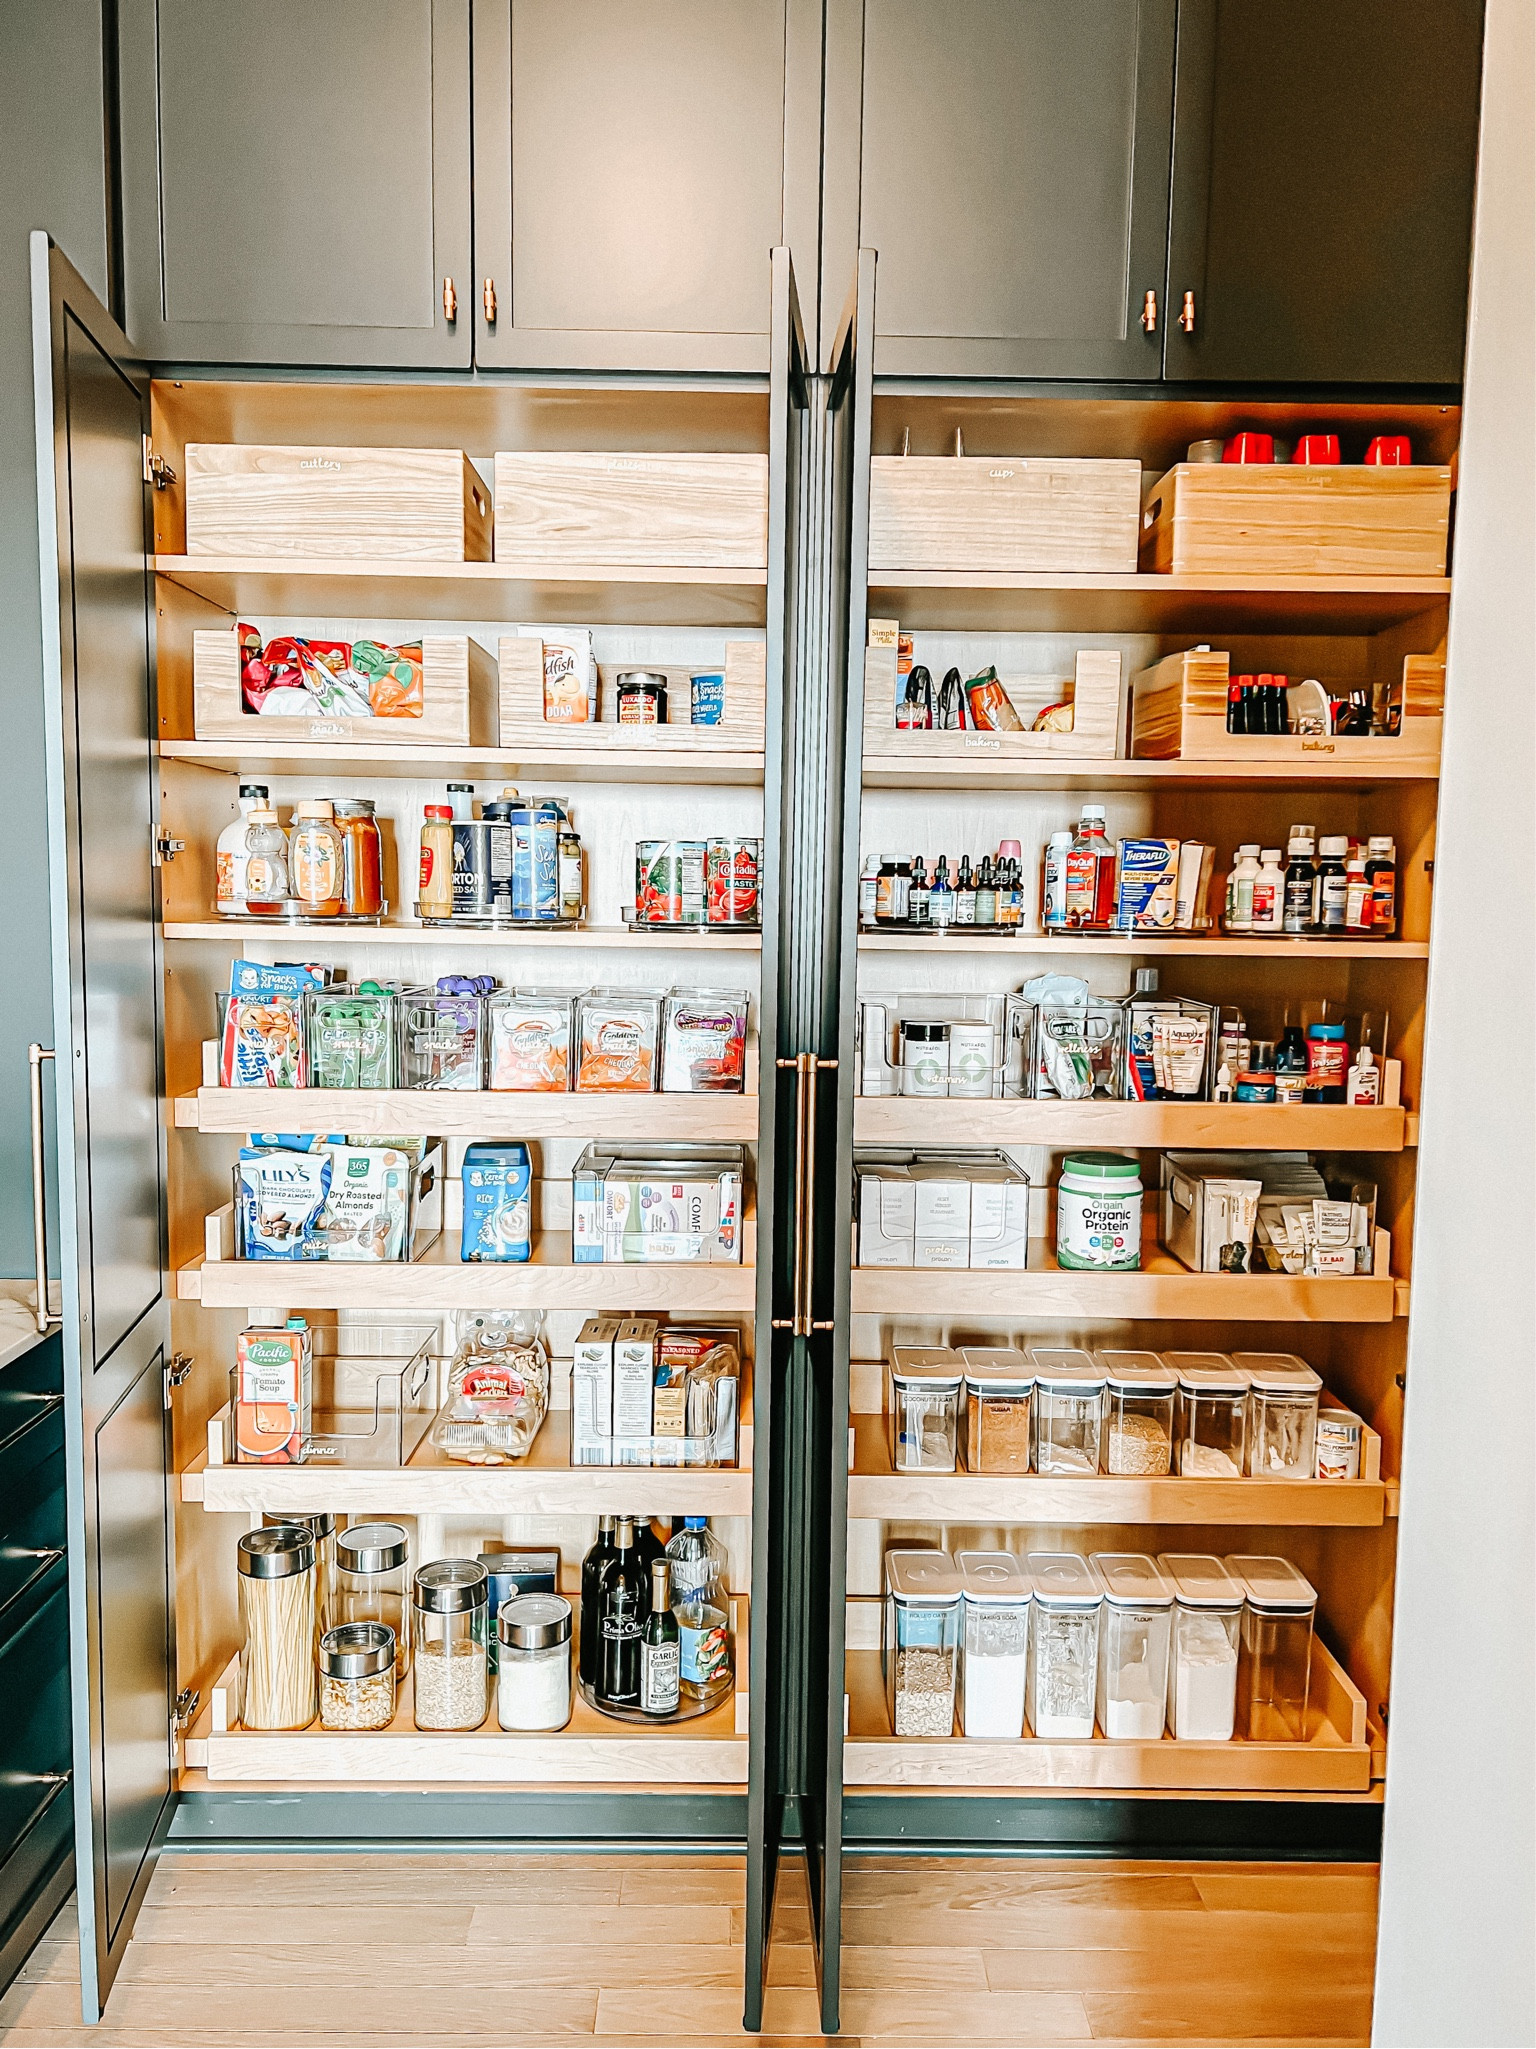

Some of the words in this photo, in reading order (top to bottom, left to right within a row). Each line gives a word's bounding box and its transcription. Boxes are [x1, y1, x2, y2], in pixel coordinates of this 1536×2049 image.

[300, 457, 341, 471] cutlery
[989, 469, 1015, 479] cups
[964, 735, 1000, 750] baking
[1302, 741, 1335, 753] baking
[1125, 849, 1166, 862] THERAFLU
[1067, 857, 1095, 869] DayQuil
[540, 862, 556, 881] Sal
[720, 863, 757, 877] Cotadin
[261, 973, 297, 985] Snacks
[261, 981, 272, 989] for
[274, 984, 293, 992] Baby
[1171, 1030, 1204, 1039] Aquaphr
[332, 1038, 369, 1049] snacks
[422, 1038, 462, 1050] snacks
[1058, 1043, 1102, 1054] wellness
[927, 1074, 968, 1085] vitamins
[349, 1161, 368, 1171] 365
[484, 1173, 505, 1181] Cereal
[343, 1180, 369, 1190] Organic
[329, 1191, 345, 1200] Dry
[346, 1190, 382, 1200] Roasted
[476, 1194, 494, 1204] RICE
[335, 1201, 374, 1210] Almonds
[1092, 1200, 1123, 1211] Orgain
[1082, 1208, 1132, 1222] Organic
[691, 1196, 702, 1254] COMFRT
[1085, 1219, 1129, 1231] Protein
[302, 1240, 329, 1250] nuts
[649, 1242, 676, 1255] baby
[924, 1243, 960, 1256] prolon
[1280, 1249, 1305, 1258] rolon
[249, 1343, 289, 1359] Pacific
[254, 1377, 286, 1386] Tomato
[474, 1376, 508, 1390] Animal
[258, 1385, 280, 1393] Soup
[301, 1444, 338, 1456] dinner
[603, 1620, 625, 1634] Prima
